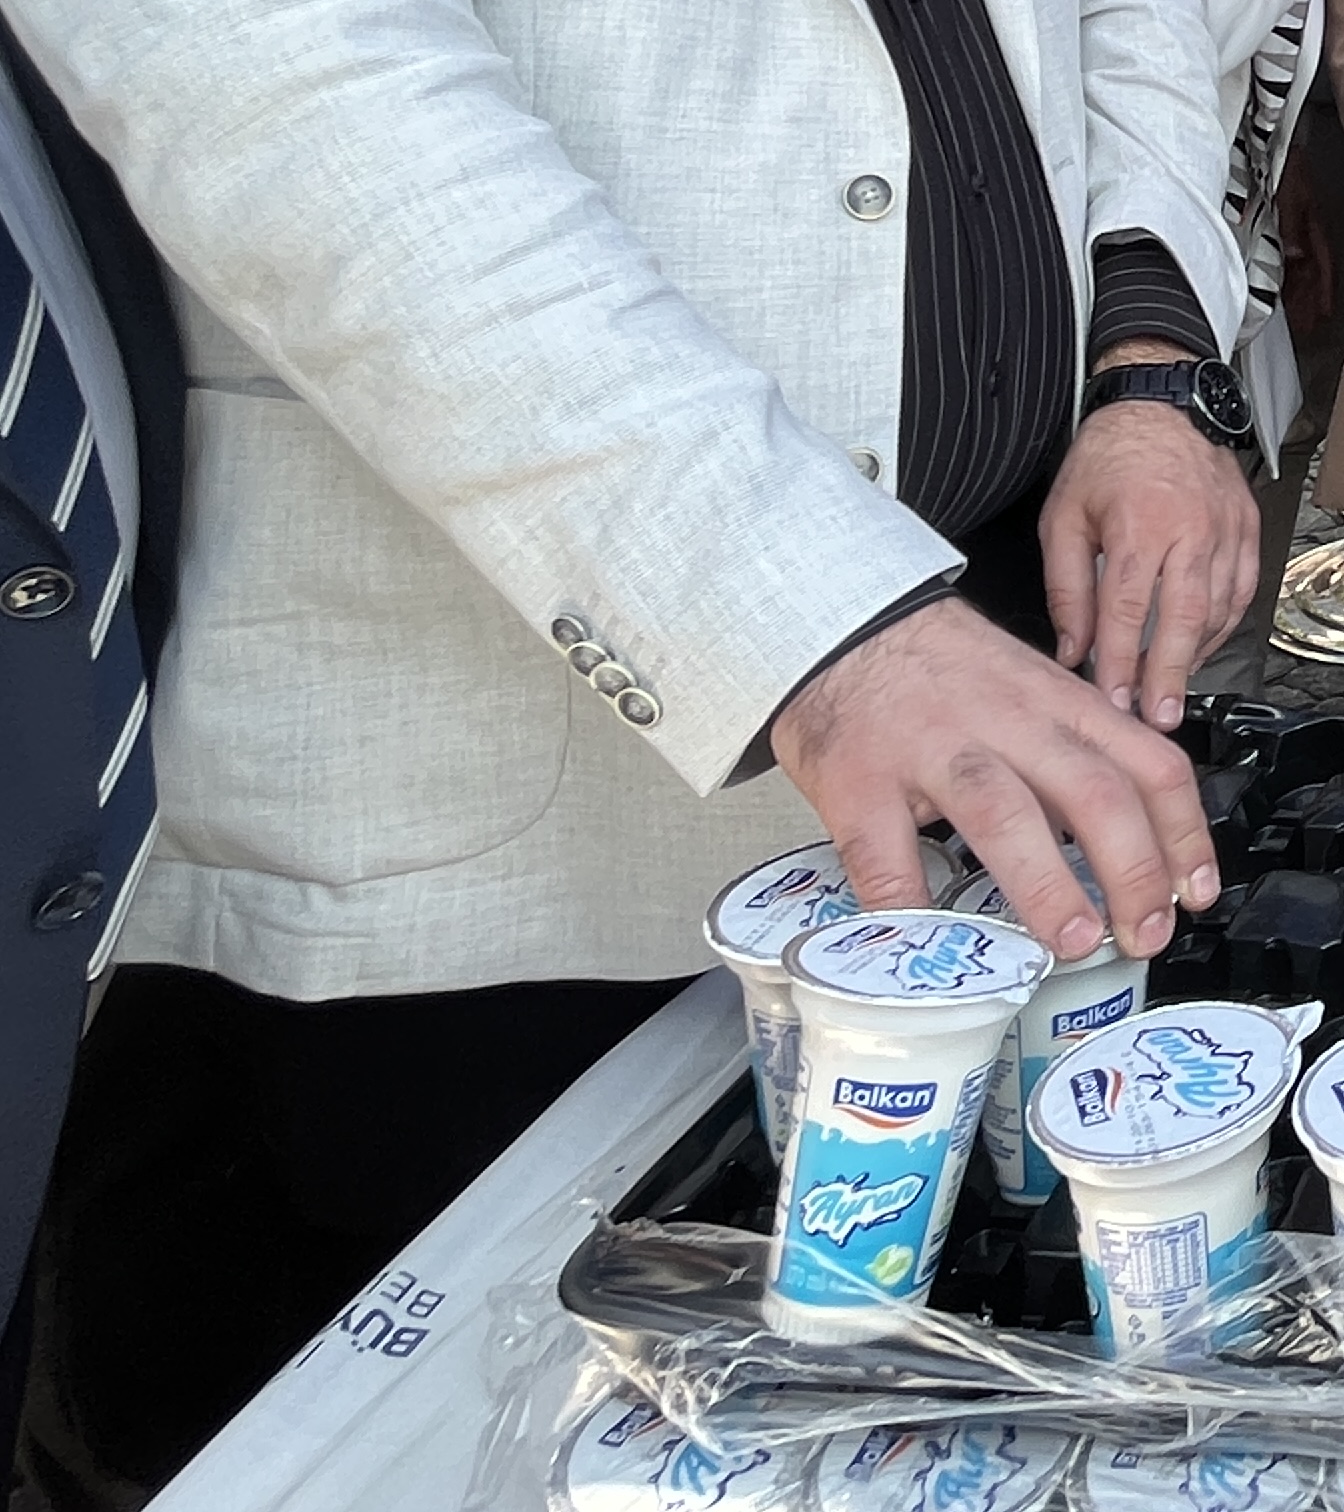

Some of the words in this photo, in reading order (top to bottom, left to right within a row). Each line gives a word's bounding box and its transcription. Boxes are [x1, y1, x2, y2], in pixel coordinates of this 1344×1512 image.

[1057, 994, 1131, 1033] Balkan
[837, 1081, 931, 1110] Balkan
[806, 1180, 915, 1234] Ayran
